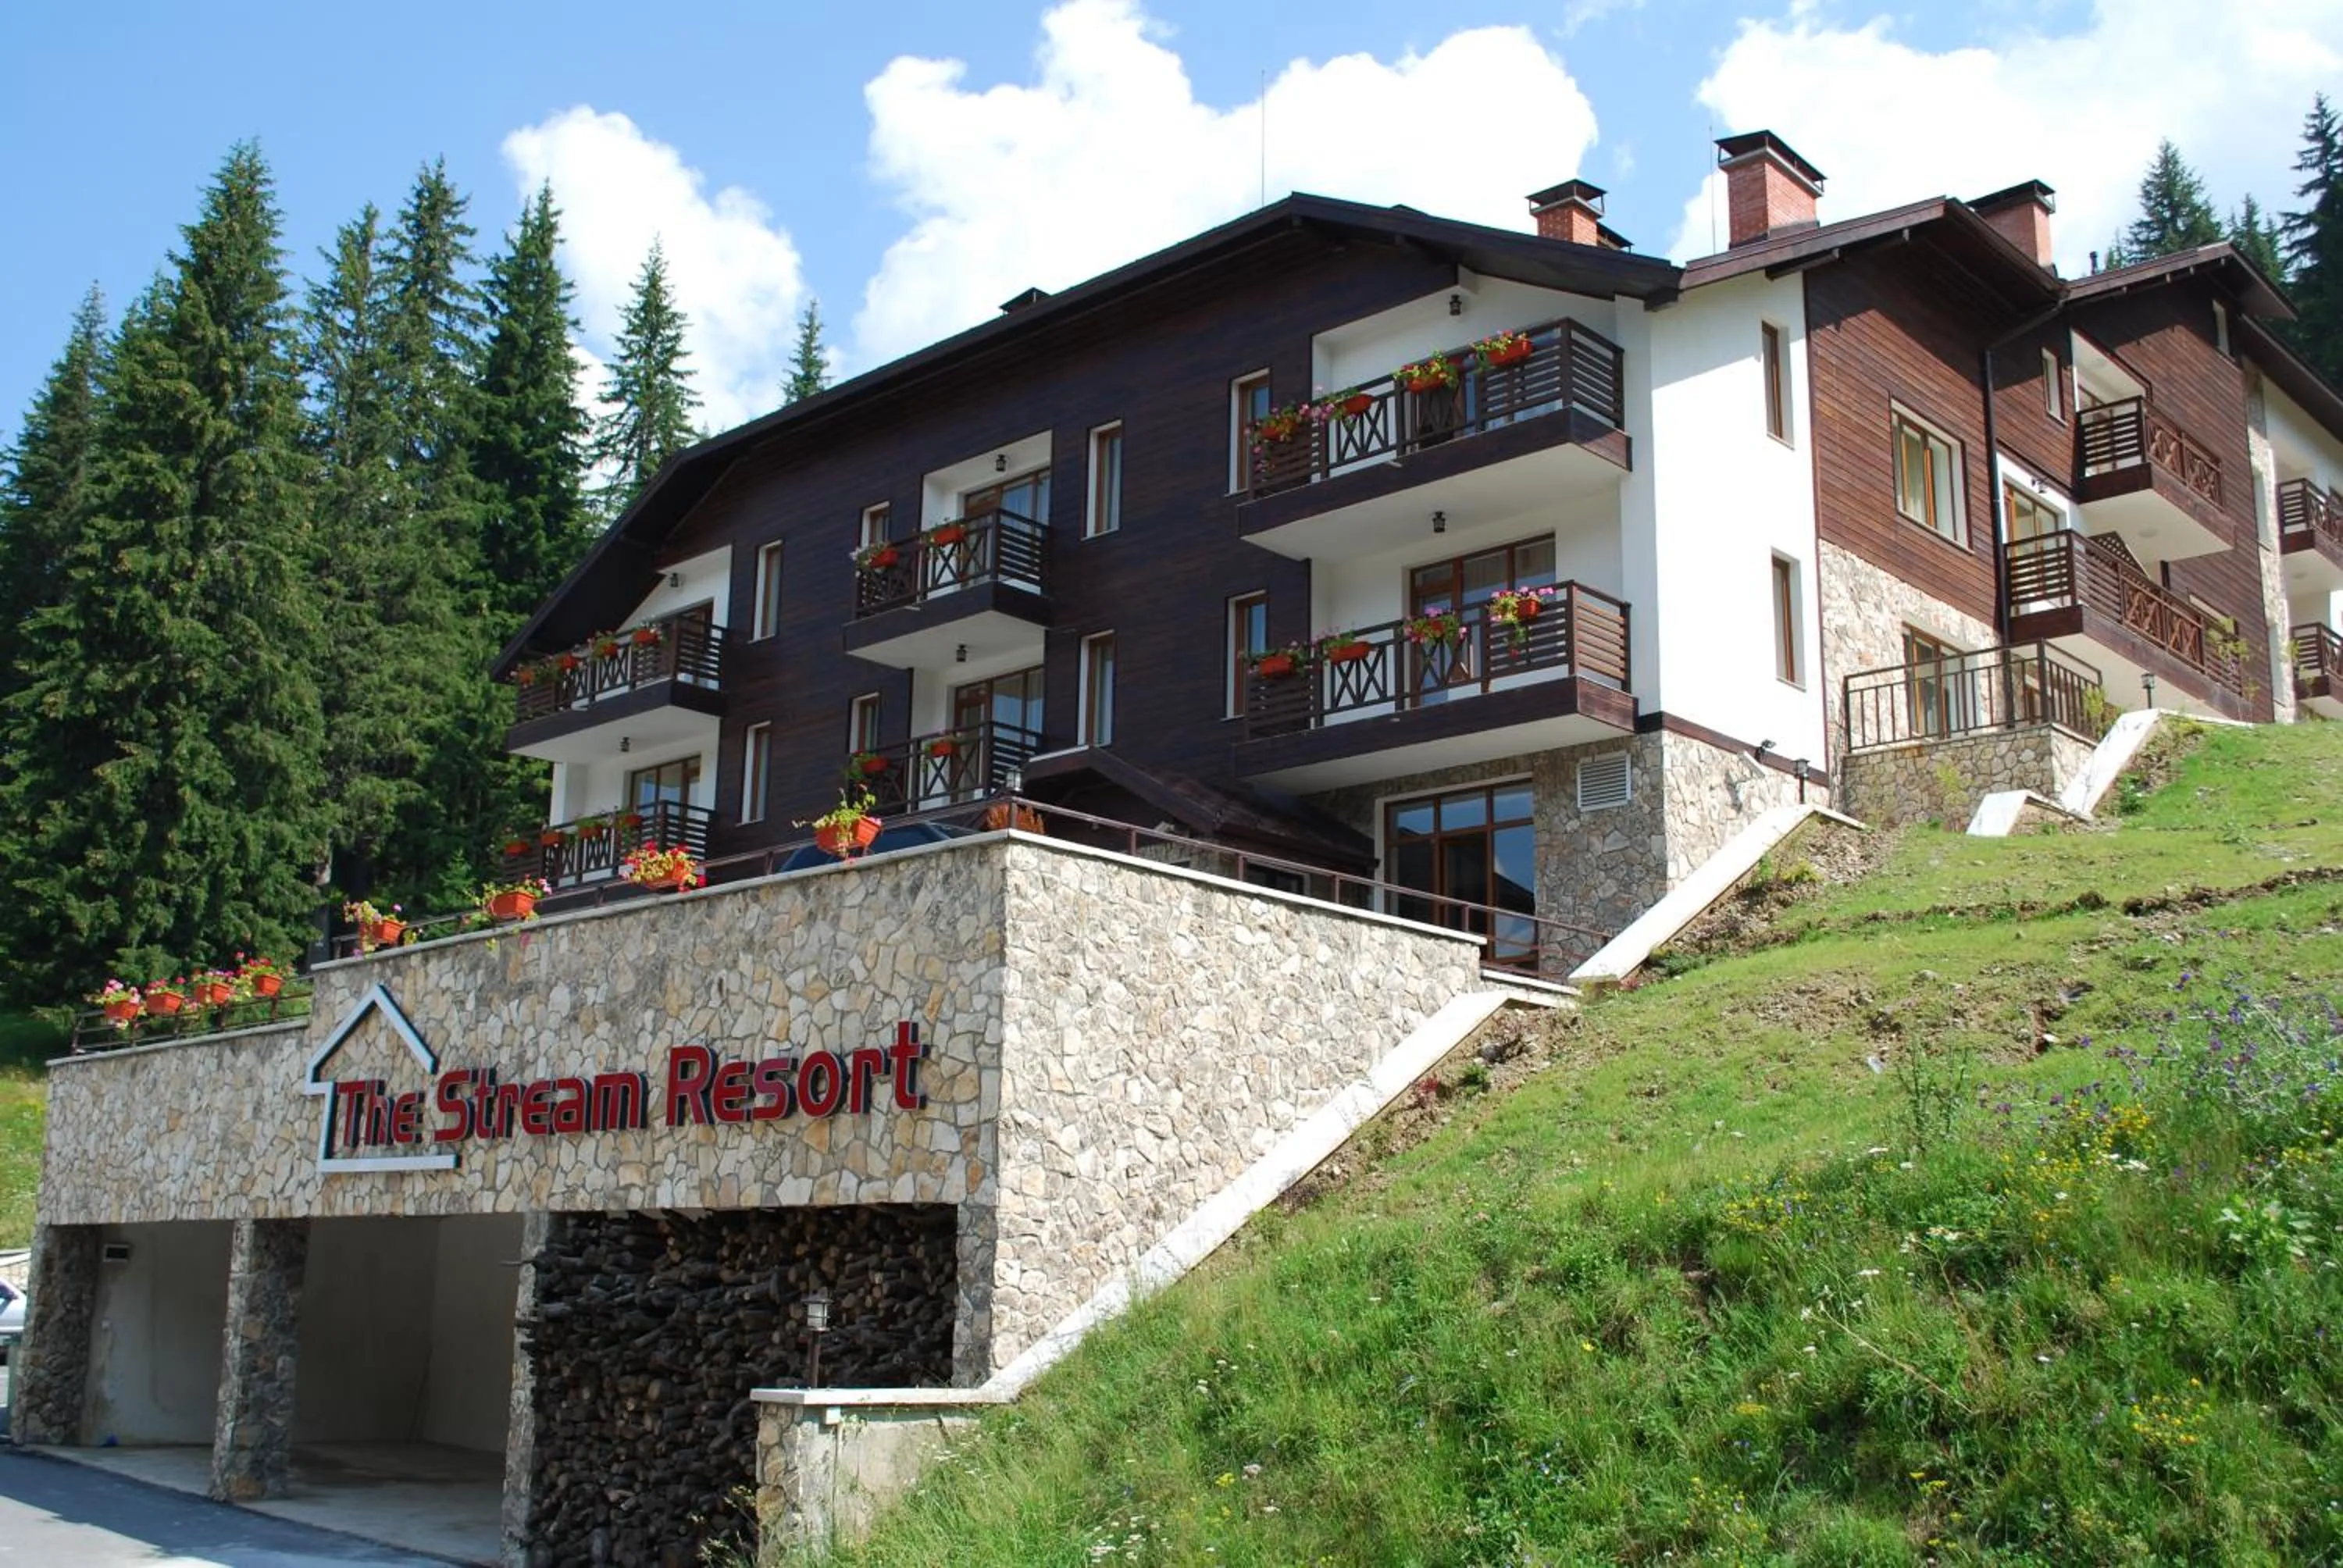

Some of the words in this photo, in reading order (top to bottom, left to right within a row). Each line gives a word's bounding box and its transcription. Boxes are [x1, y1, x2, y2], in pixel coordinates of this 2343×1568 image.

[336, 1080, 422, 1146] The
[433, 1067, 647, 1144] Stream
[666, 1021, 928, 1126] Resort
